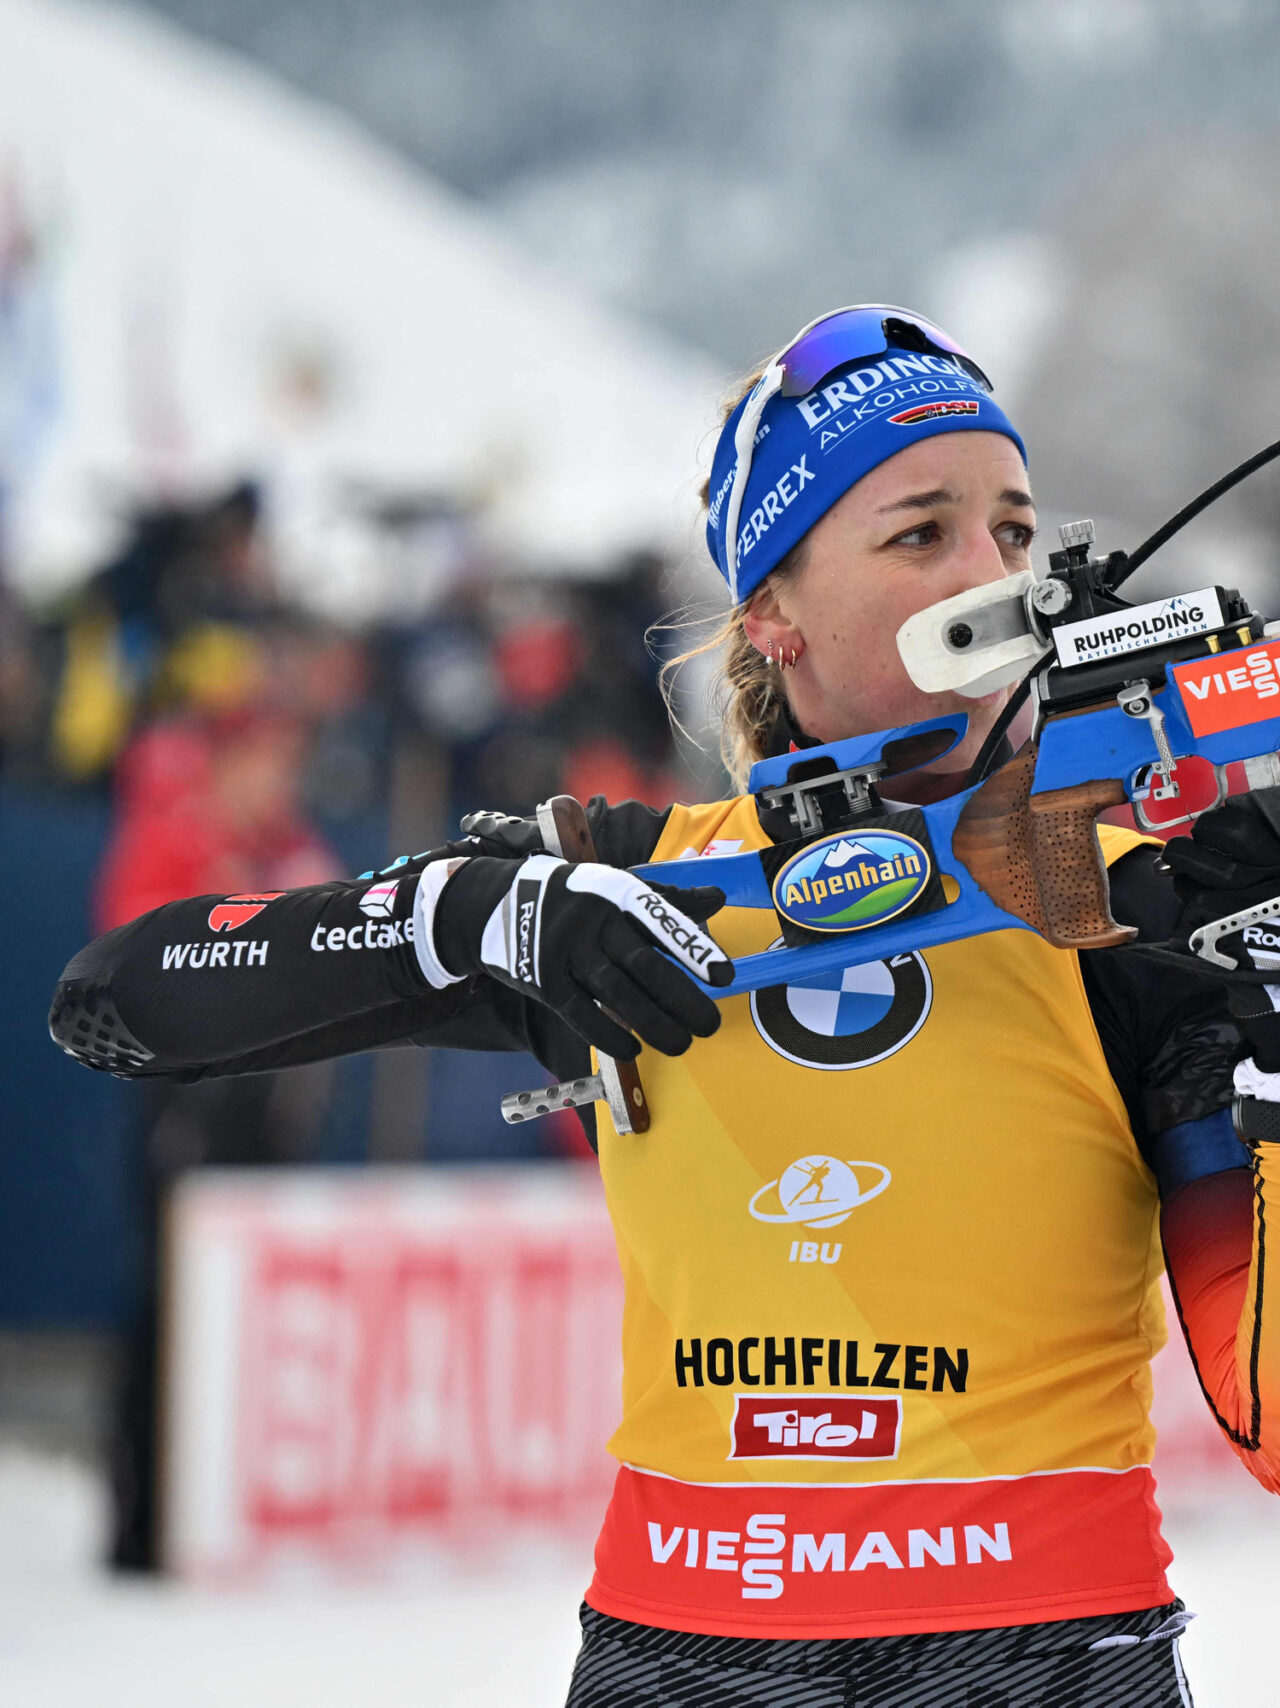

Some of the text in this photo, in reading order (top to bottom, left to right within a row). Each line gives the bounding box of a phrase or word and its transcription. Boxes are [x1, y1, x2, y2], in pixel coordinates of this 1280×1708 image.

[1074, 606, 1204, 653] RUHPOLDING
[1078, 623, 1208, 662] BAYERISCHE ALPEN
[786, 852, 922, 908] Alpenhain
[788, 1240, 843, 1265] IBU
[675, 1336, 969, 1393] HOCHFILZEN
[753, 1409, 878, 1448] Tirol
[646, 1513, 1014, 1600] VIESSMANN
